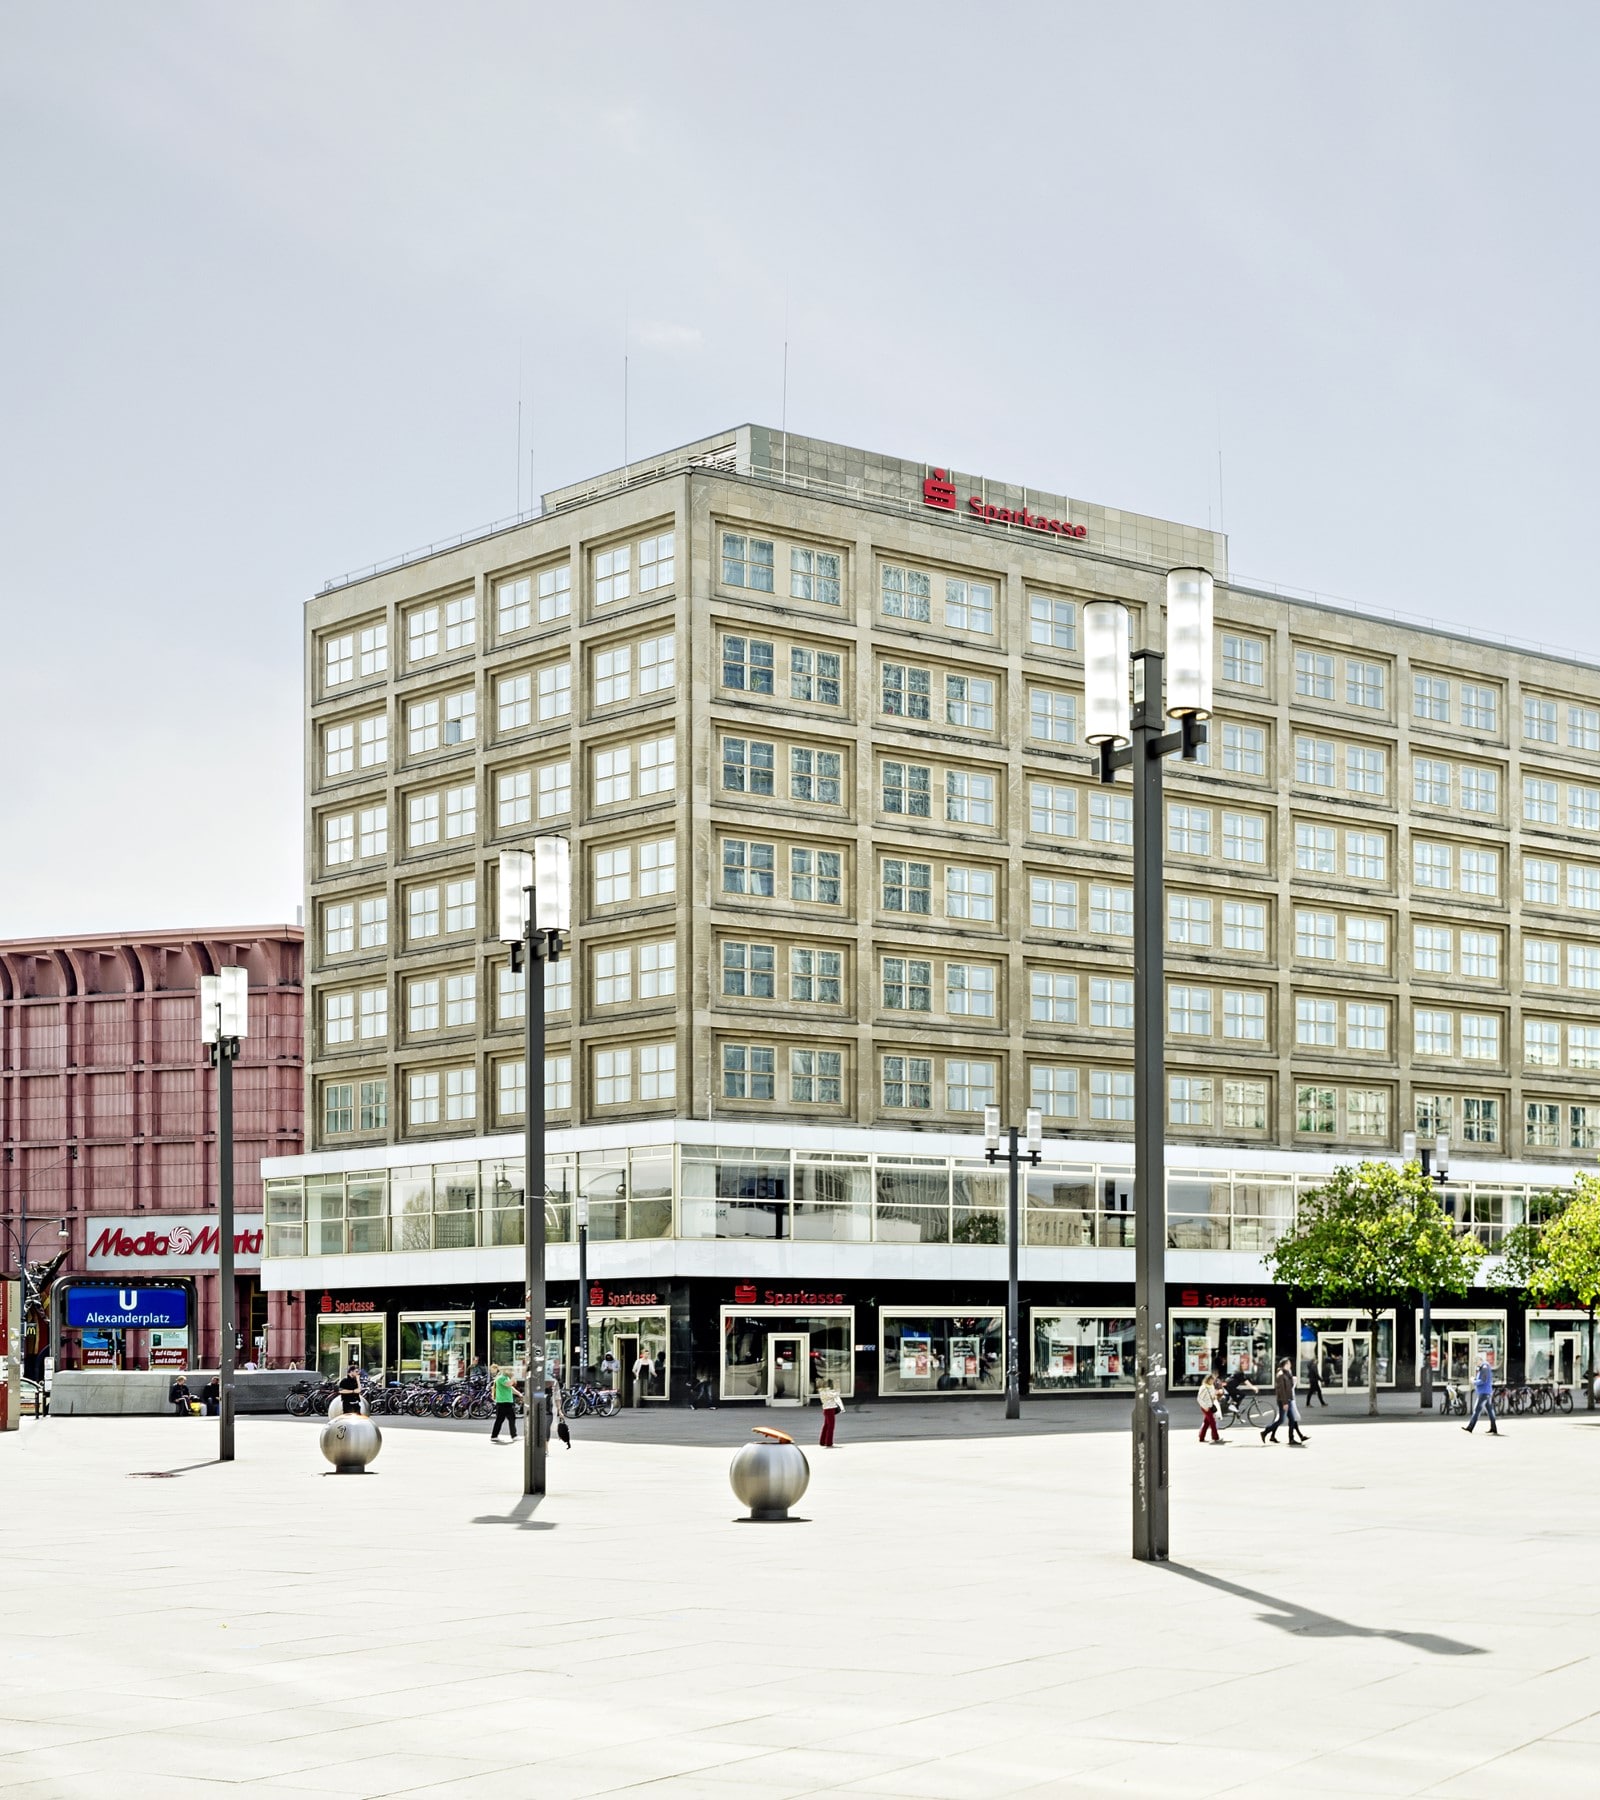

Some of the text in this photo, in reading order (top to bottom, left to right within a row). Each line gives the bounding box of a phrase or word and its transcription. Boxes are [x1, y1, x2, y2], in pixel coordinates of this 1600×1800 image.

[968, 496, 1087, 539] Sparkasse
[88, 1225, 264, 1257] Media Mrkt
[119, 1290, 138, 1311] U
[335, 1299, 375, 1312] Sparkasse
[608, 1290, 657, 1307] Sparkasse
[764, 1290, 843, 1306] Sparkasse
[1204, 1294, 1268, 1308] Sparkasse
[86, 1312, 170, 1326] Alexanderplatz
